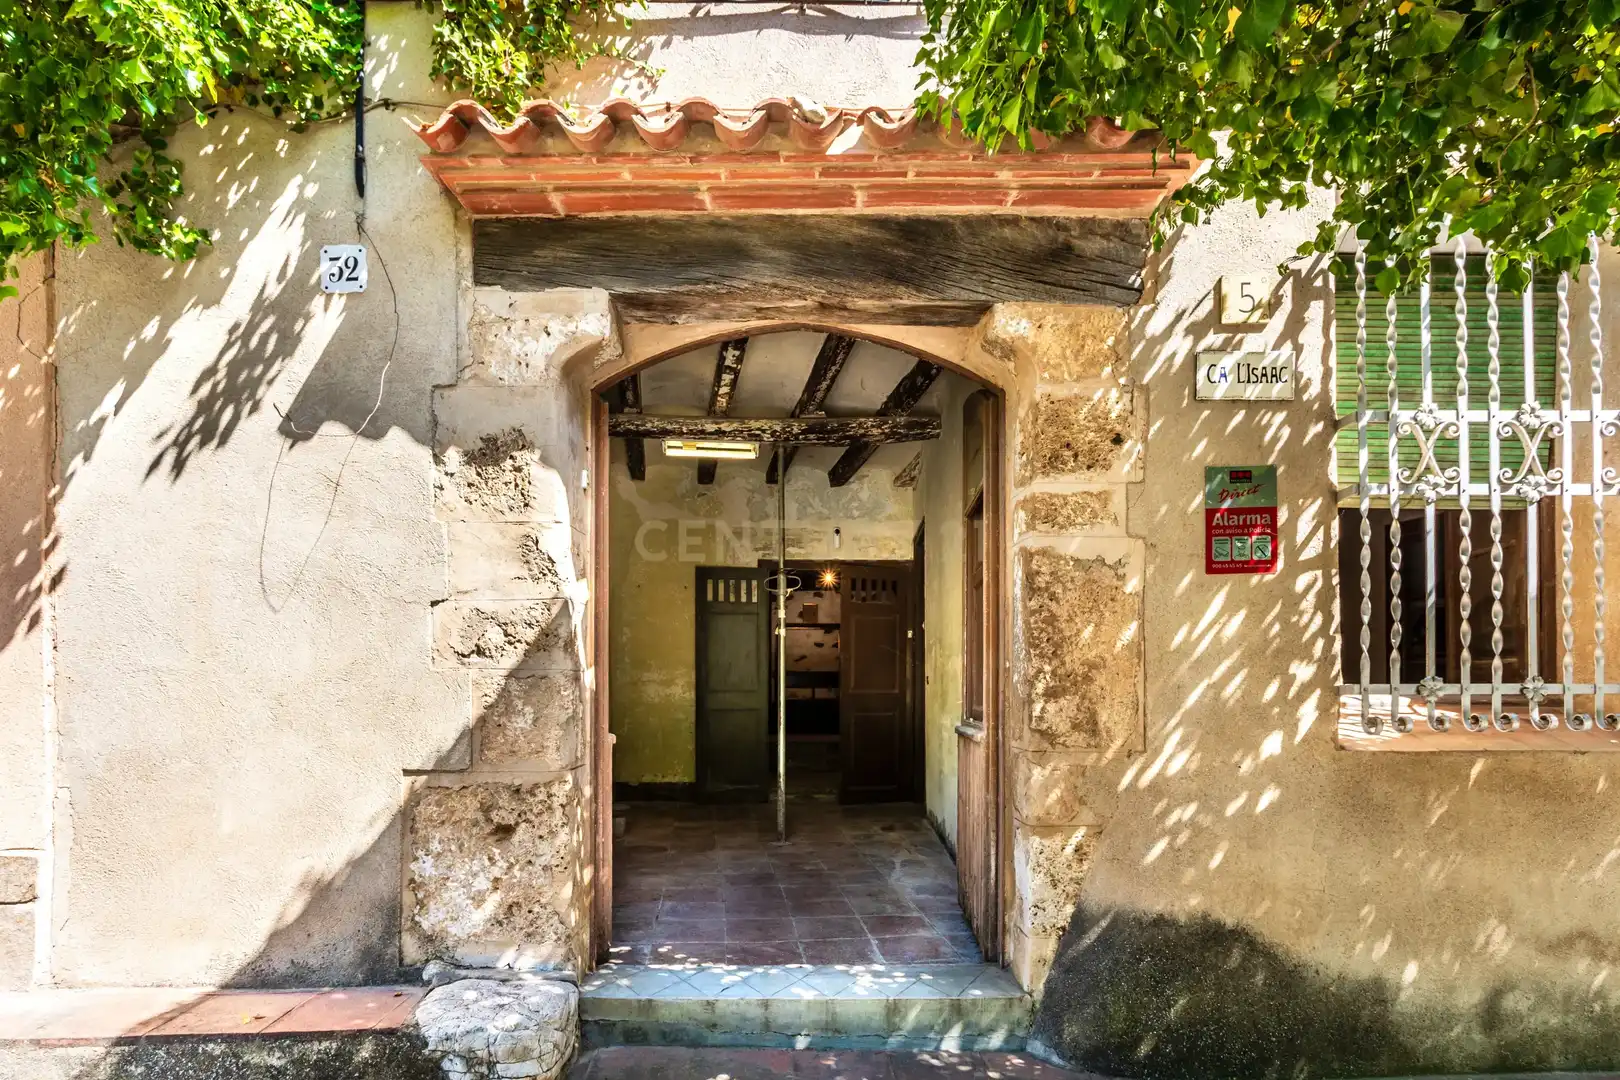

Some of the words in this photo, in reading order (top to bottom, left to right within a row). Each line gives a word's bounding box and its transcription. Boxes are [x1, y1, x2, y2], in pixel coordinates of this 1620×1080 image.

[328, 255, 360, 283] 32
[1238, 282, 1256, 313] 5
[1206, 363, 1228, 384] CA
[1211, 512, 1272, 526] Alarma
